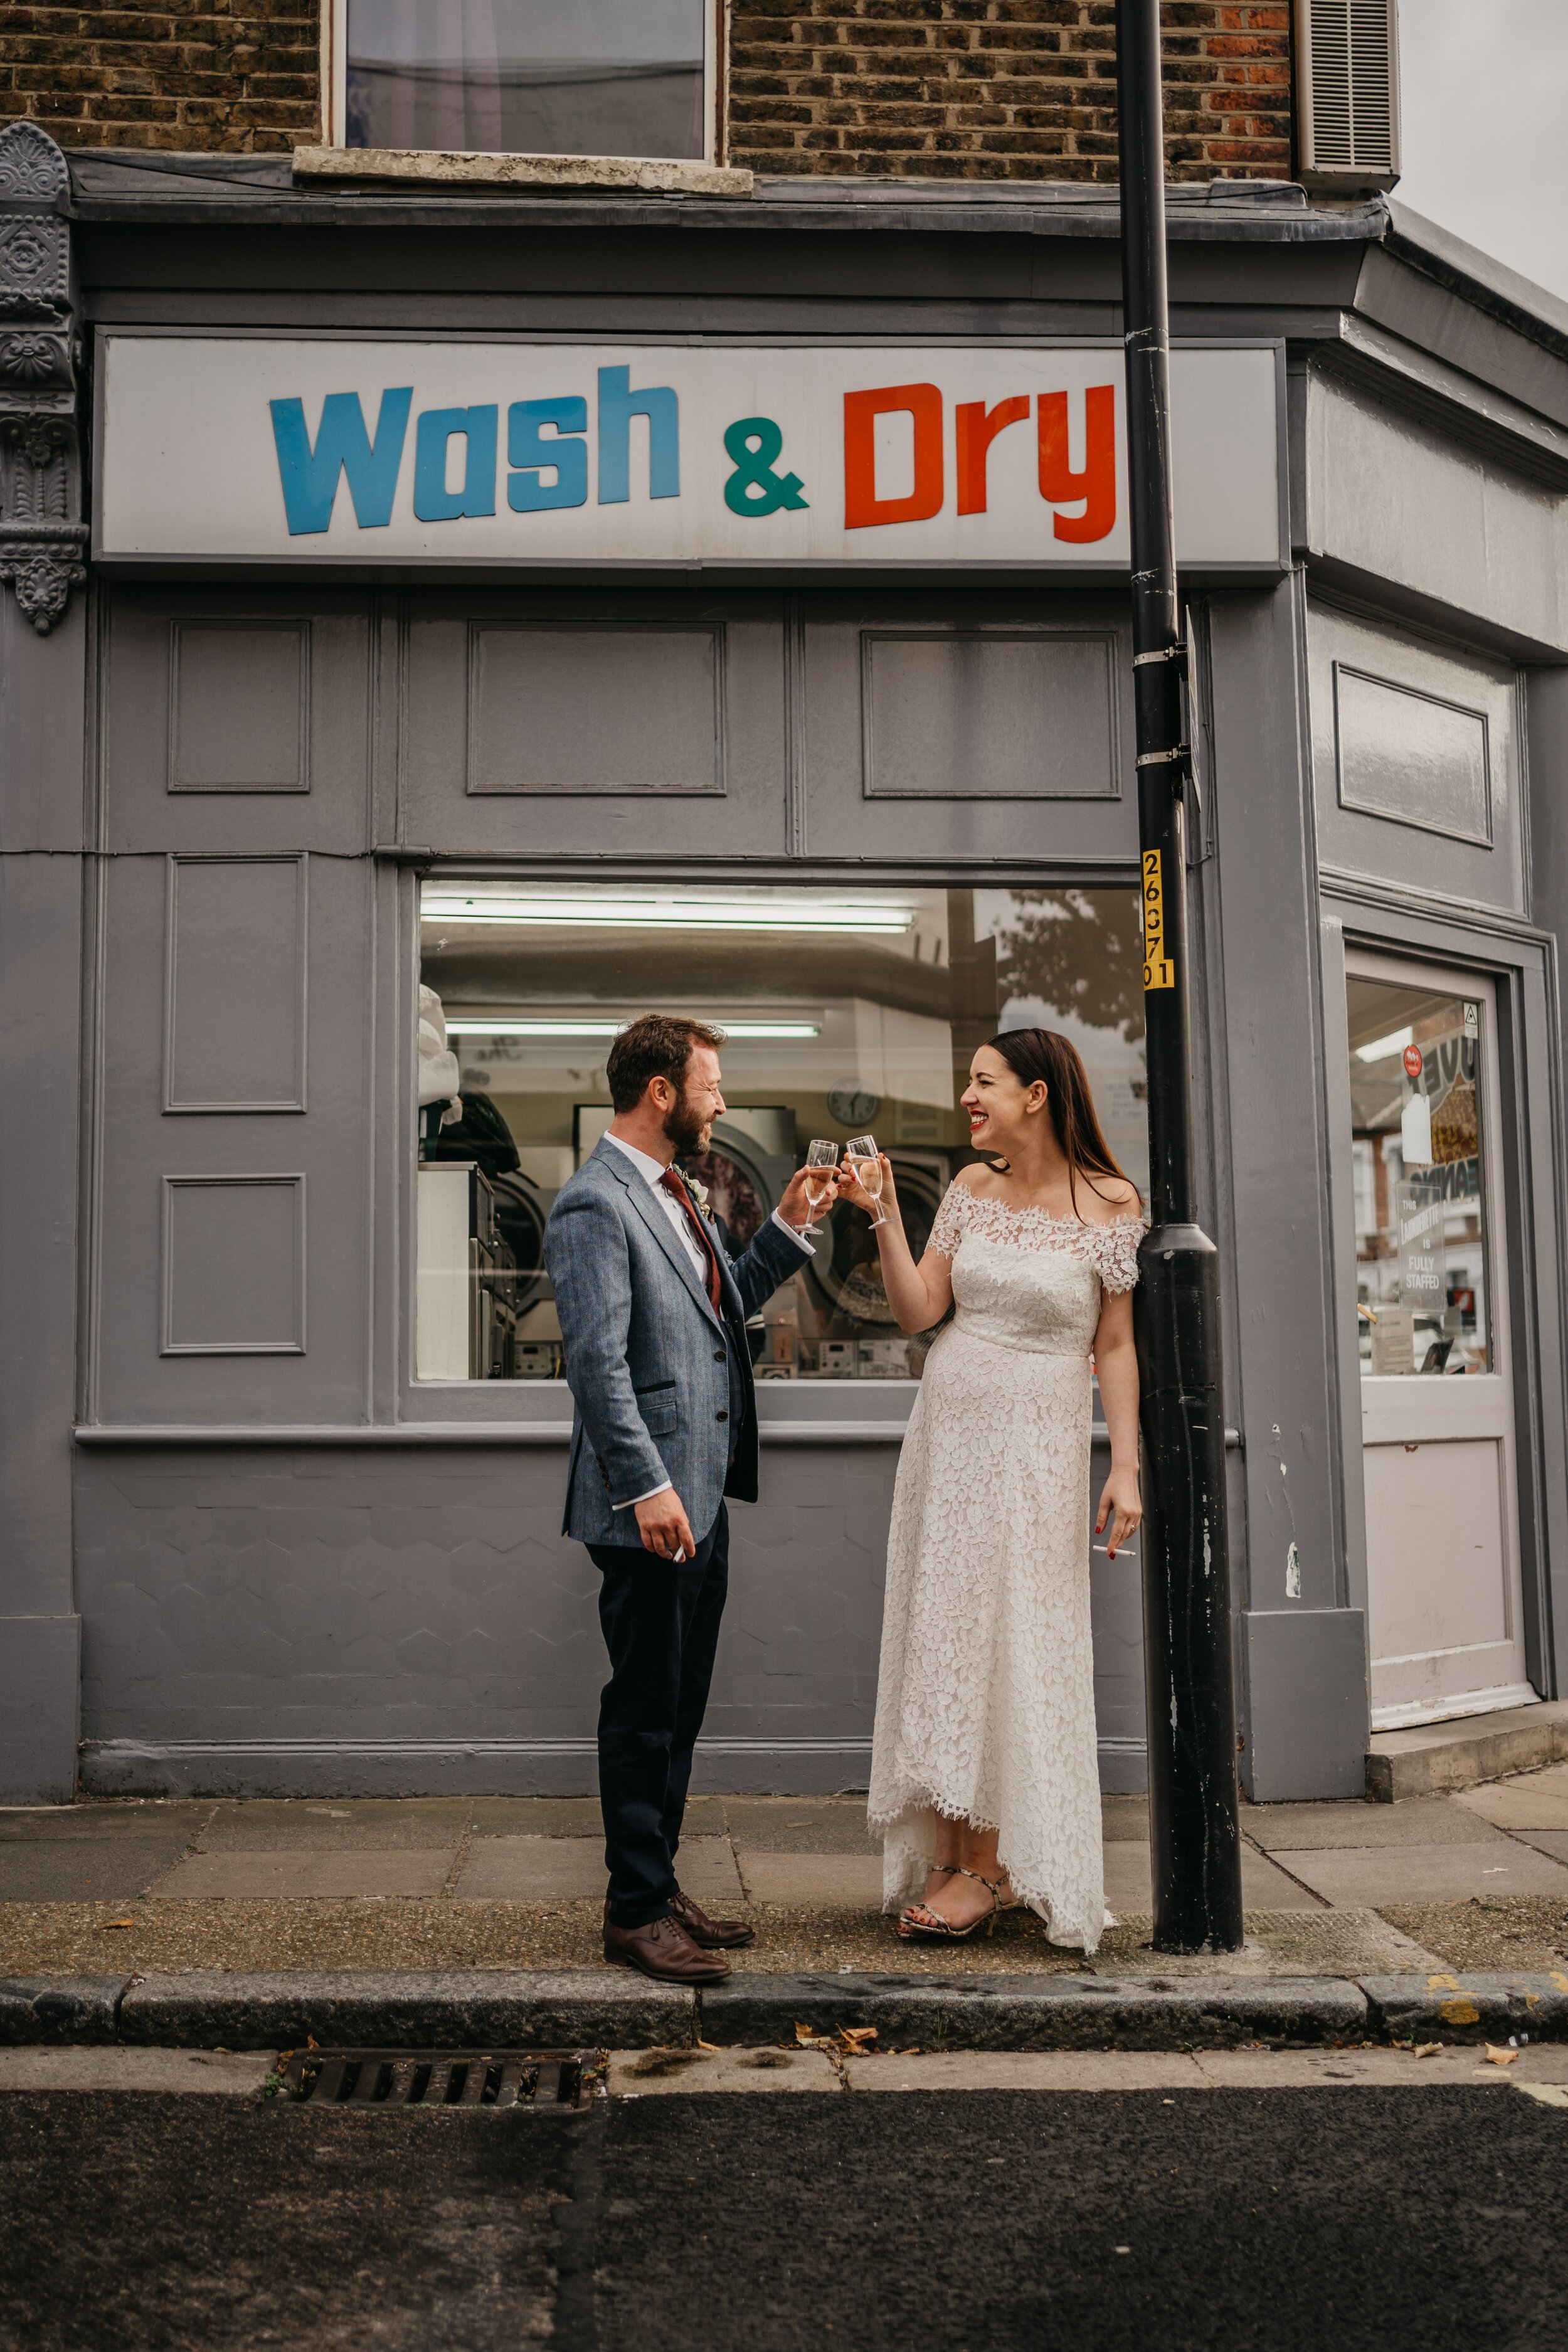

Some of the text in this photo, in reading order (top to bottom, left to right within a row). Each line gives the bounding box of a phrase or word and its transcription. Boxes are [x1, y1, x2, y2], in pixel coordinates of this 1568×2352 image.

[269, 365, 1116, 543] Wash & Dry
[1402, 1200, 1416, 1210] THIS
[1401, 1202, 1439, 1245] LAUNDERETTE
[1423, 1238, 1431, 1249] IS
[1409, 1256, 1434, 1271] FULLY
[1406, 1274, 1439, 1290] STAFFED
